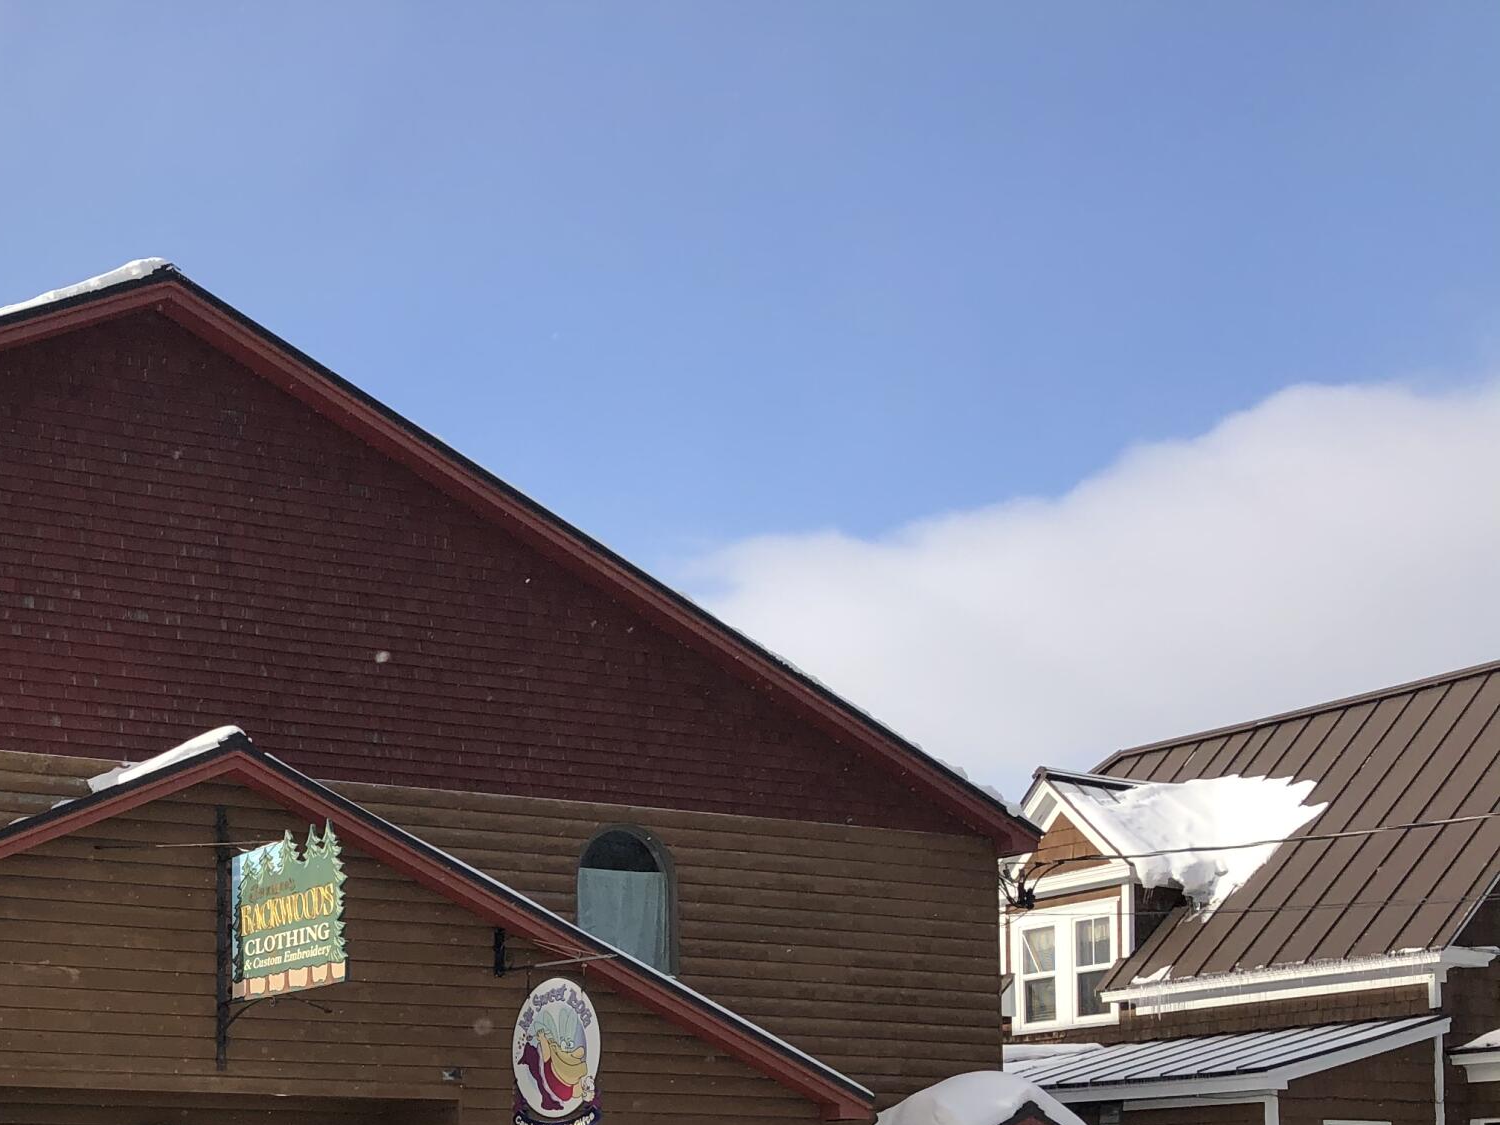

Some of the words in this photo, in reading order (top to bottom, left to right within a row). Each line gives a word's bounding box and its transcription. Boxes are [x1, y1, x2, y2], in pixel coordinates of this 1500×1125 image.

[240, 882, 334, 936] BACKWOODS
[244, 923, 330, 956] CLOTHING
[243, 959, 253, 971] &
[252, 955, 283, 969] Custom
[283, 944, 331, 963] Embroidery
